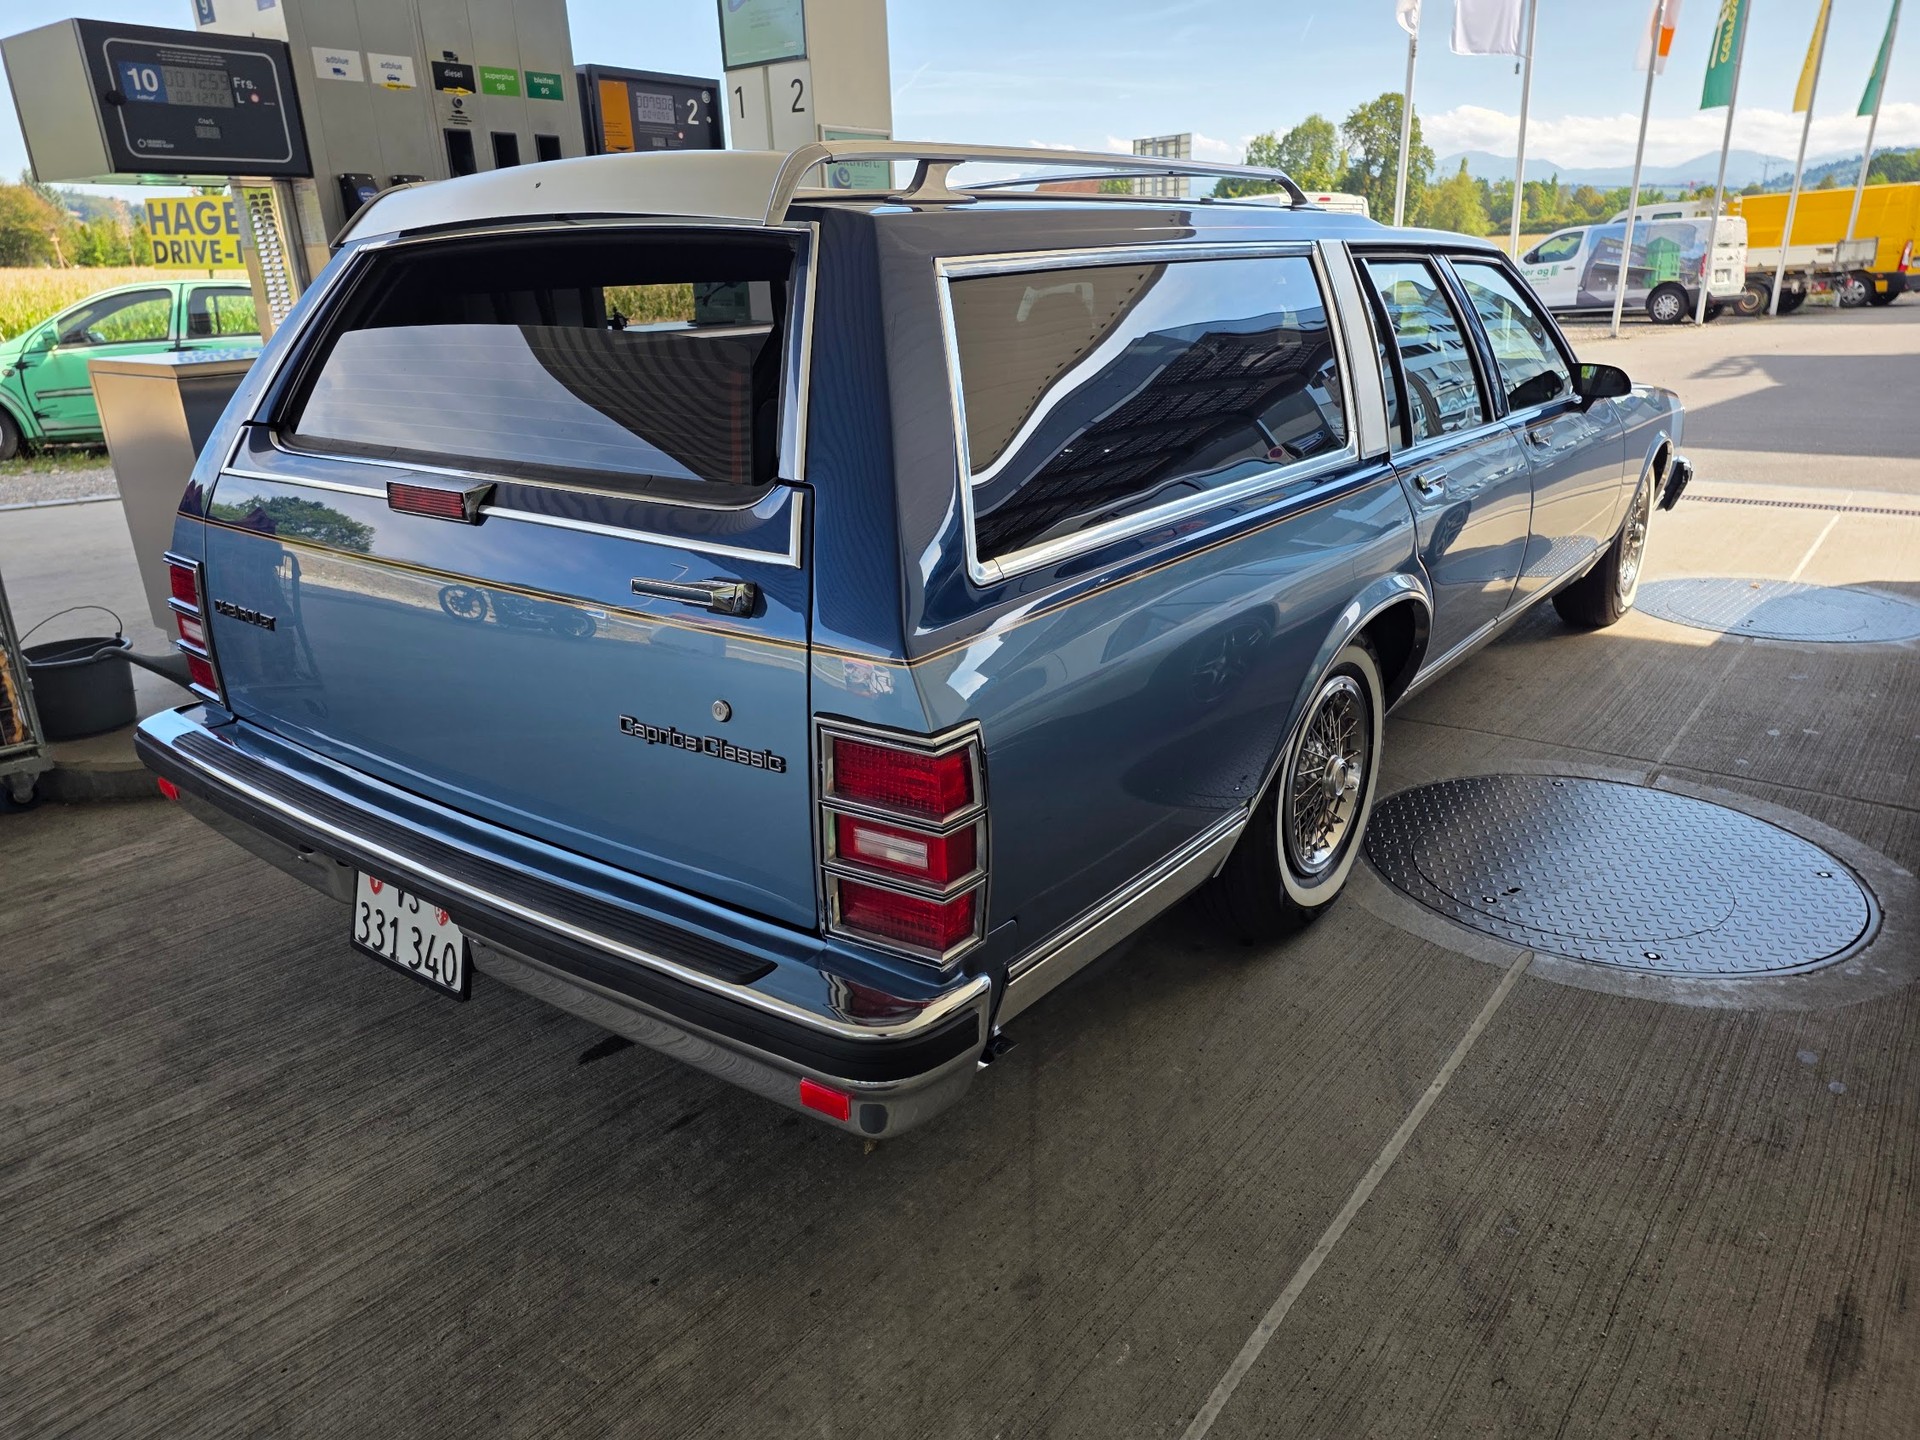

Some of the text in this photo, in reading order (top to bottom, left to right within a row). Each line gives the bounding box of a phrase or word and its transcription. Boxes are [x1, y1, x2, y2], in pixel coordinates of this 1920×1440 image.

[127, 67, 159, 92] 10
[444, 69, 463, 78] diesel
[484, 72, 515, 82] superplus
[233, 77, 257, 89] Frs.
[533, 76, 555, 85] bleifrei
[496, 83, 506, 91] 98
[540, 87, 550, 95] 95
[236, 91, 246, 103] L
[791, 78, 805, 113] 2
[734, 86, 745, 119] 1
[686, 98, 700, 125] 2
[1537, 268, 1549, 278] ag
[618, 713, 787, 774] Caprice Classic
[358, 901, 399, 961] 331
[408, 926, 458, 987] 340
